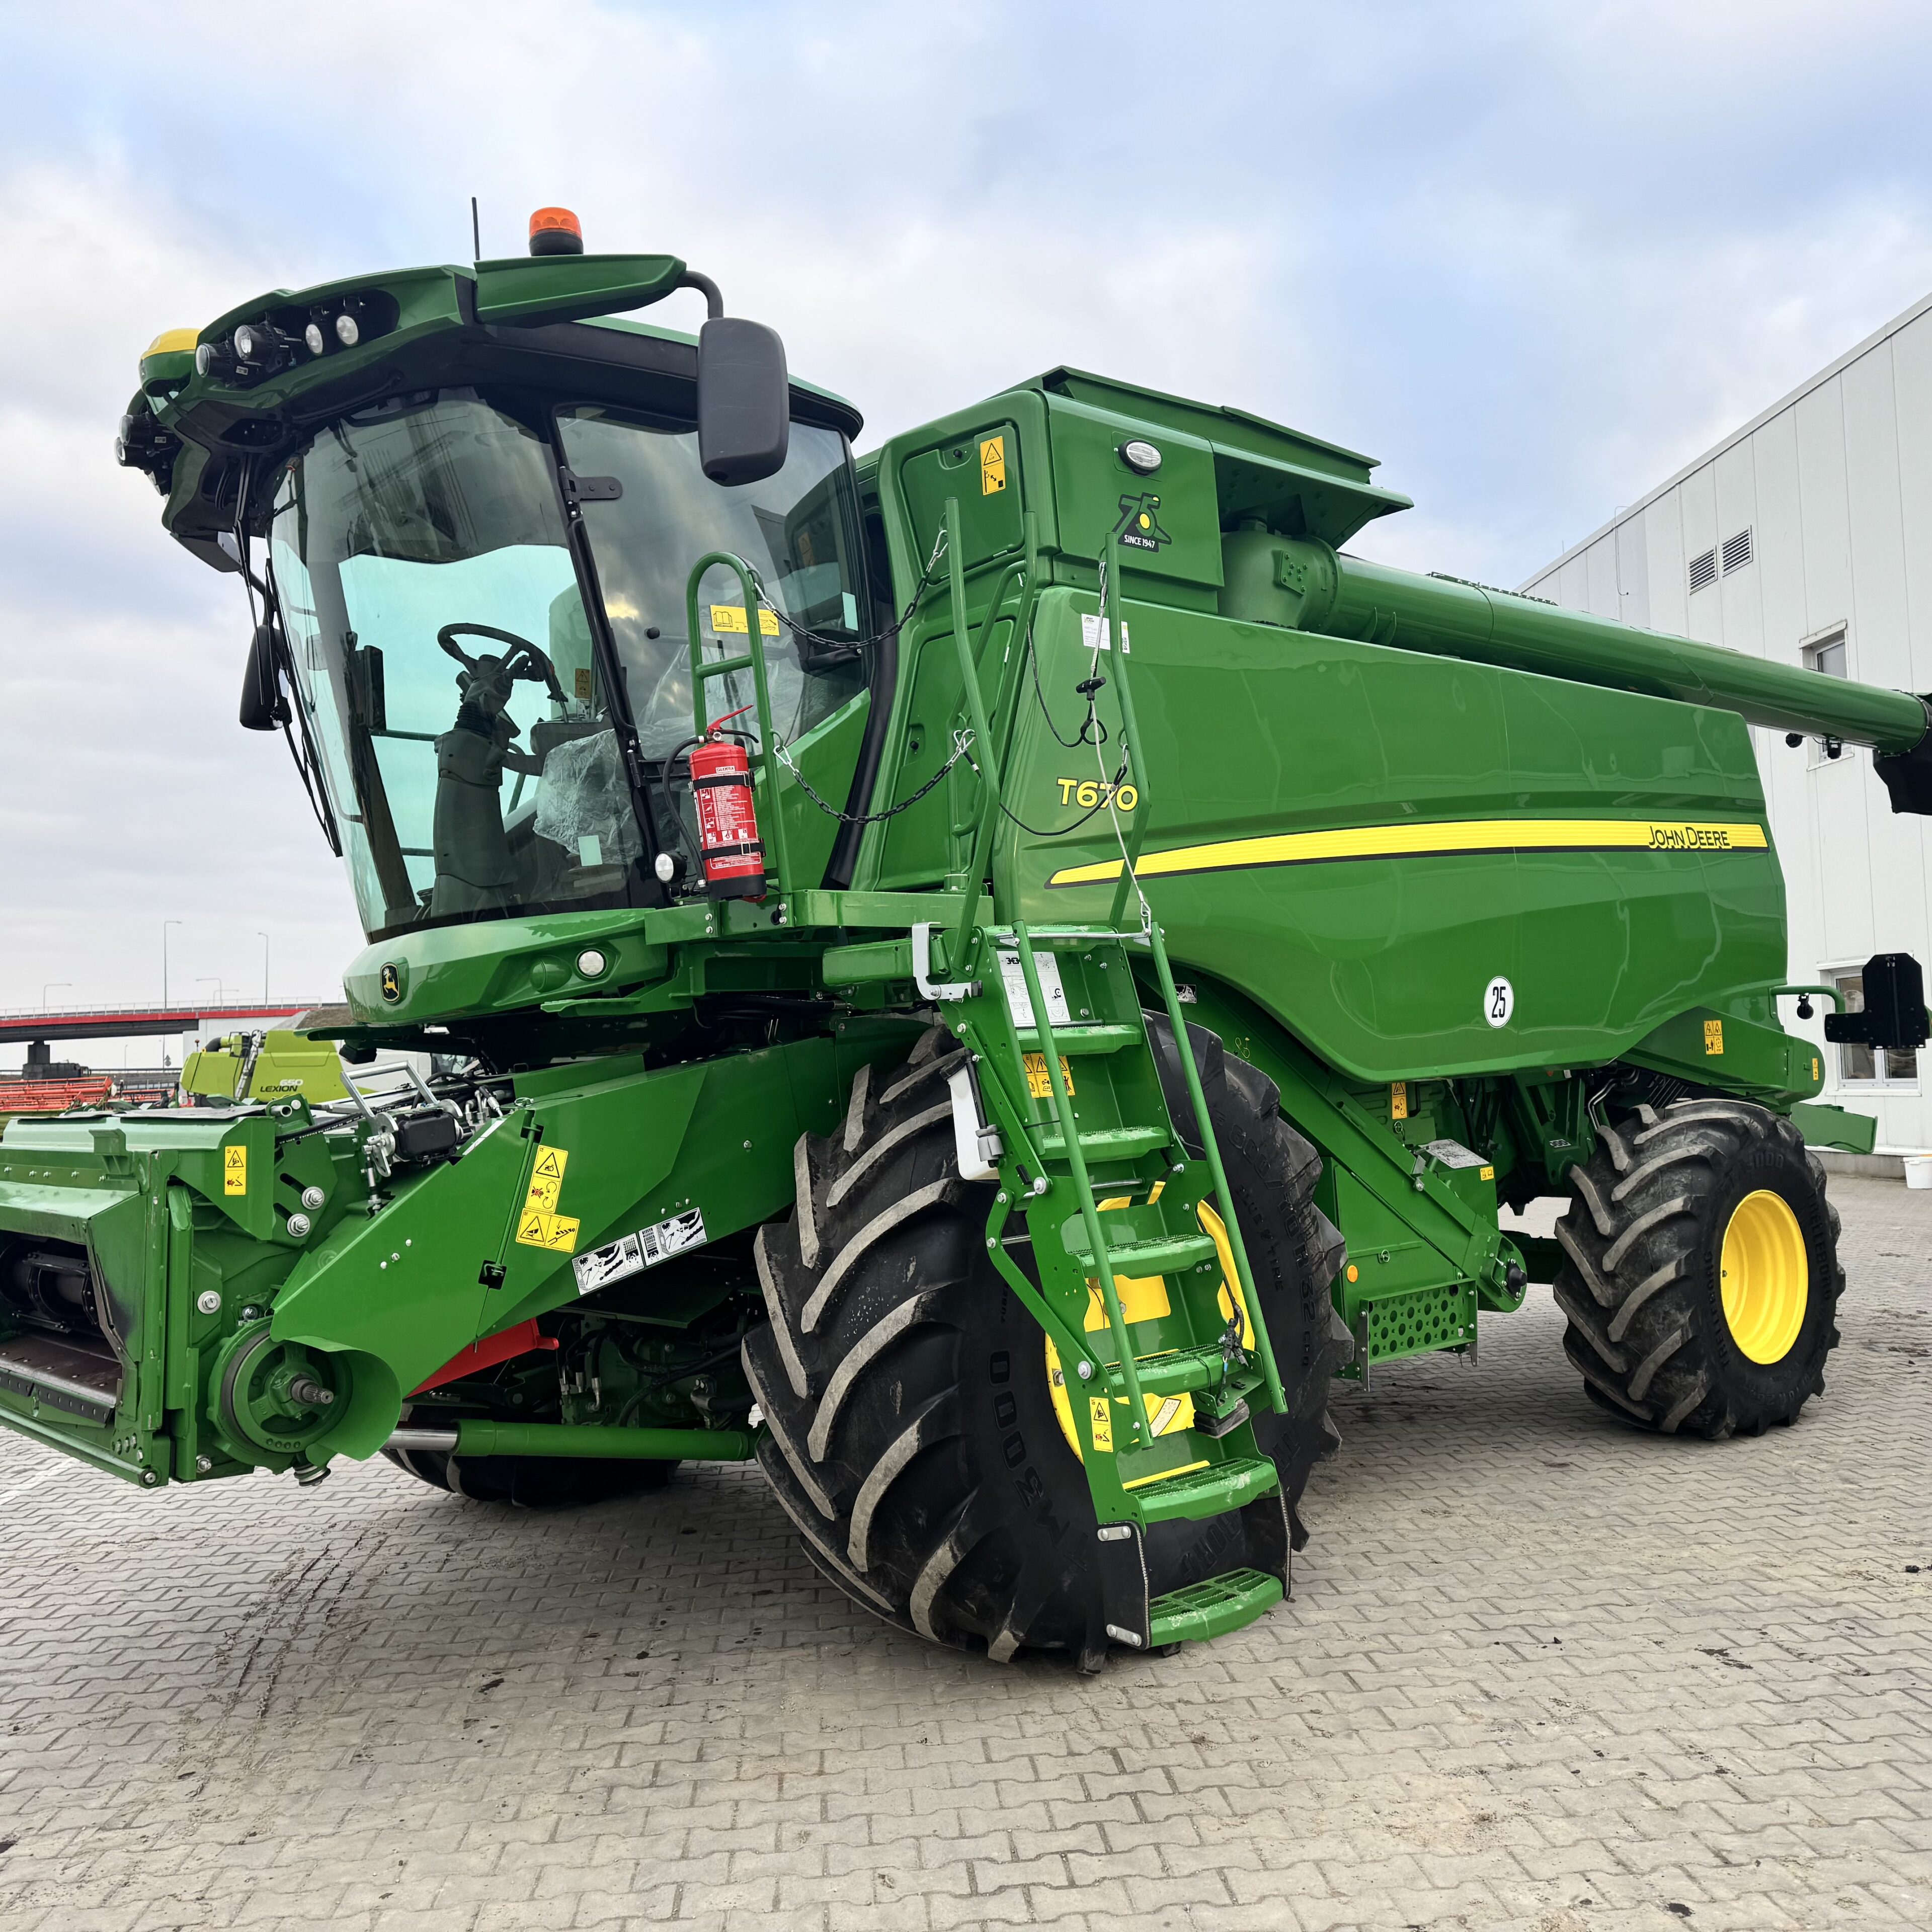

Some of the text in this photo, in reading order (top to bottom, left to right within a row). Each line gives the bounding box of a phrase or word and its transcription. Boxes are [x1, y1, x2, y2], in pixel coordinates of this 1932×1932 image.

[1124, 534, 1156, 549] SINCE 1947
[1057, 777, 1139, 811] T670
[1649, 826, 1731, 847] JOHN DEERE
[1492, 986, 1506, 1018] 25
